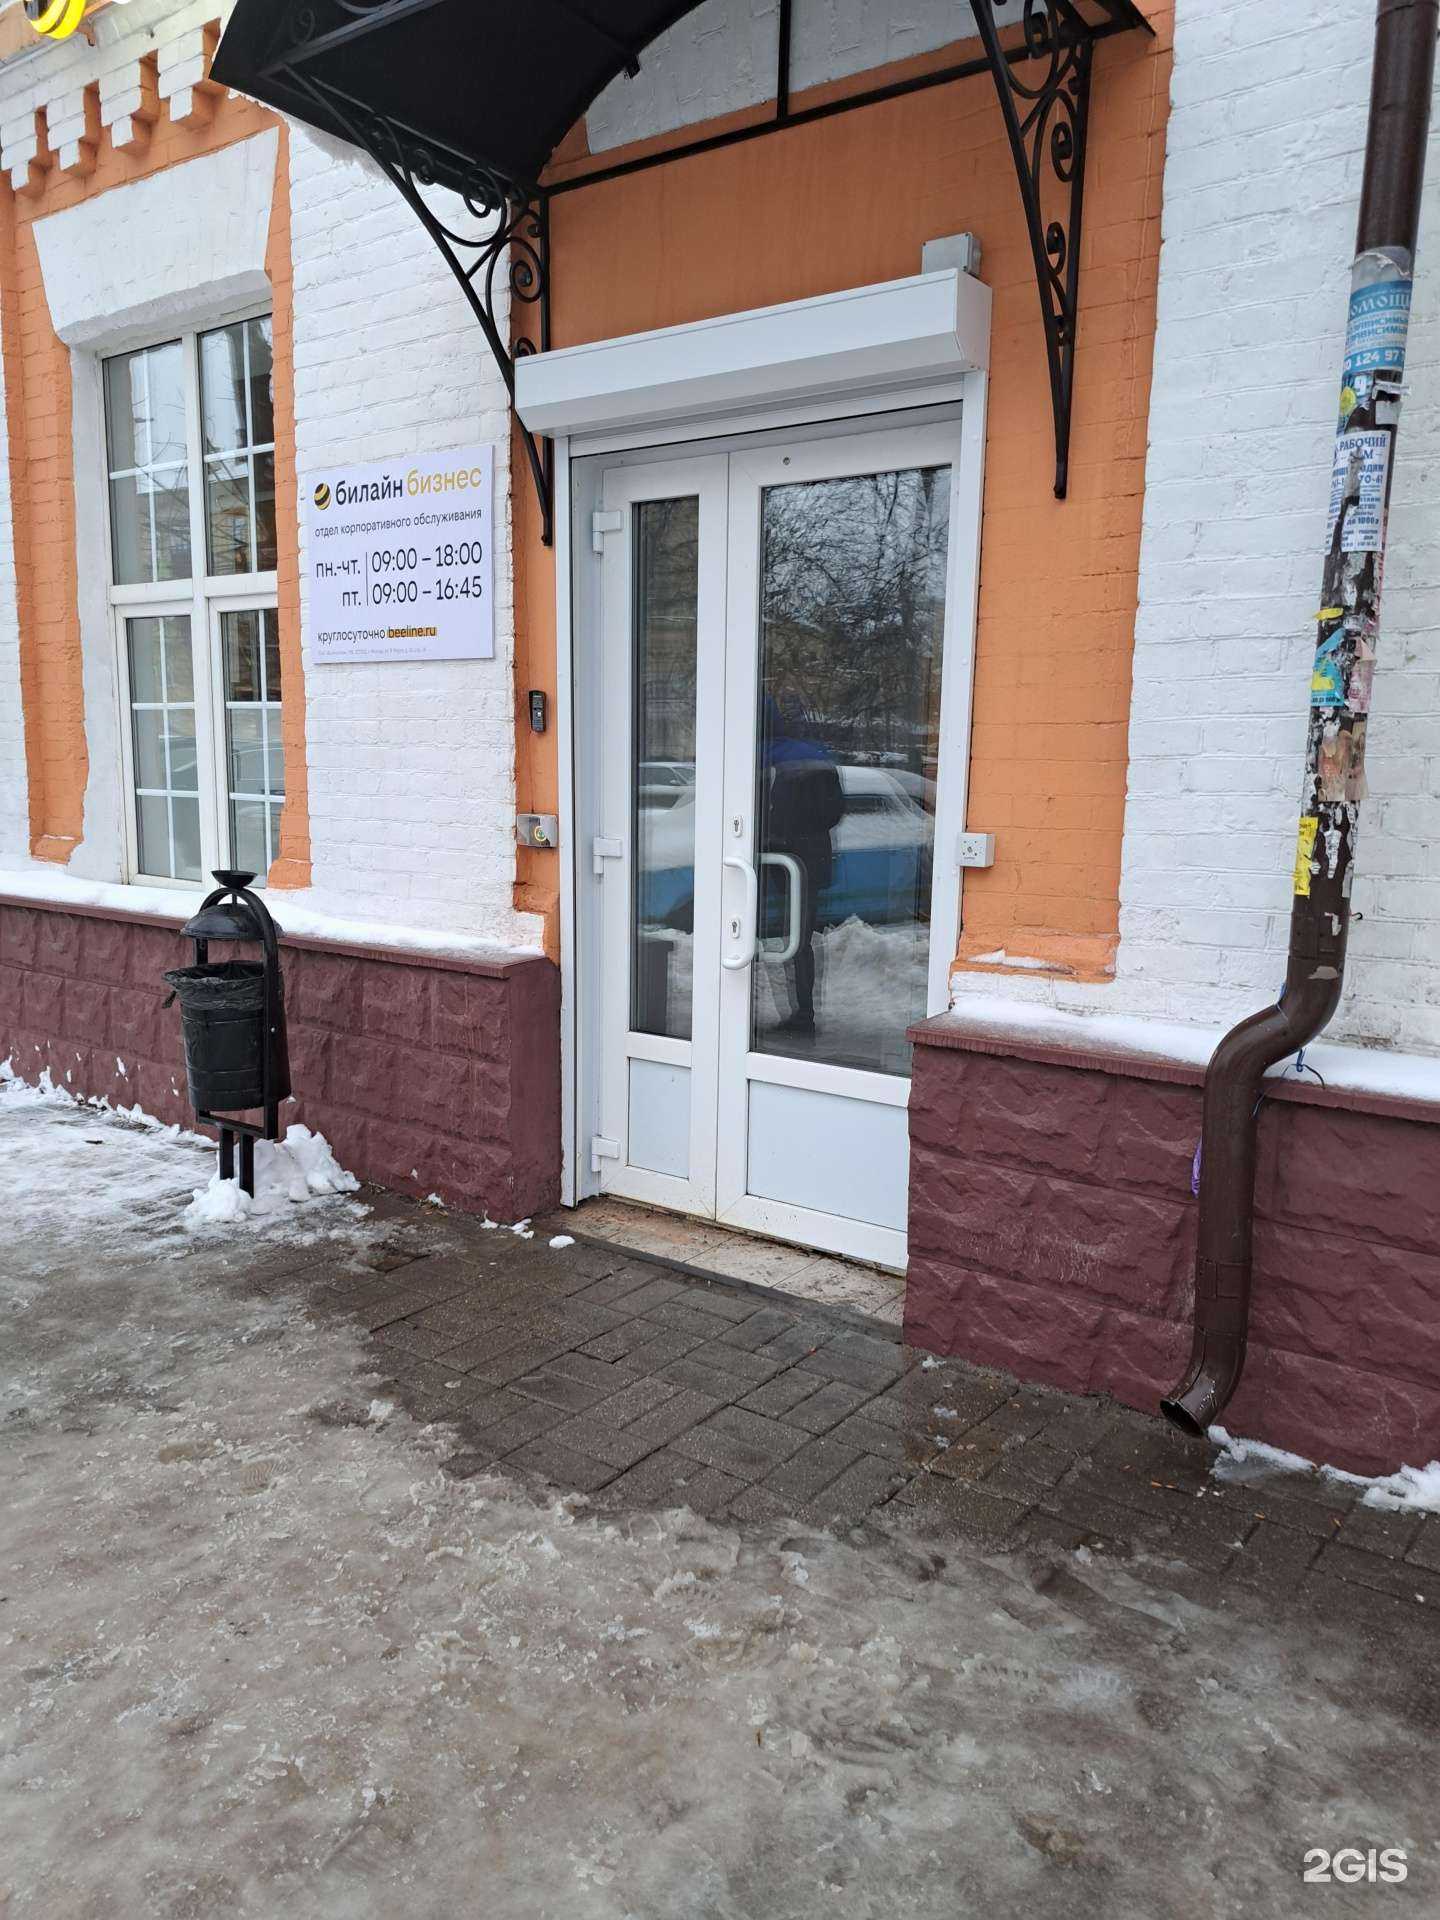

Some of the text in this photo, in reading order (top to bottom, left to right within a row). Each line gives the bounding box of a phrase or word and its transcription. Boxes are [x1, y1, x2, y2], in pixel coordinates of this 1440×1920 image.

[1340, 434, 1386, 450] РАБОЧИЙ
[336, 467, 482, 505] билайн бизнес
[315, 509, 482, 540] отдел корпоративного обслуживания
[372, 548, 417, 572] 09:00
[435, 541, 482, 567] 18:00
[372, 581, 418, 604] 09:00
[435, 575, 482, 600] 16:45
[317, 625, 436, 645] круглосуточно beeline.ru
